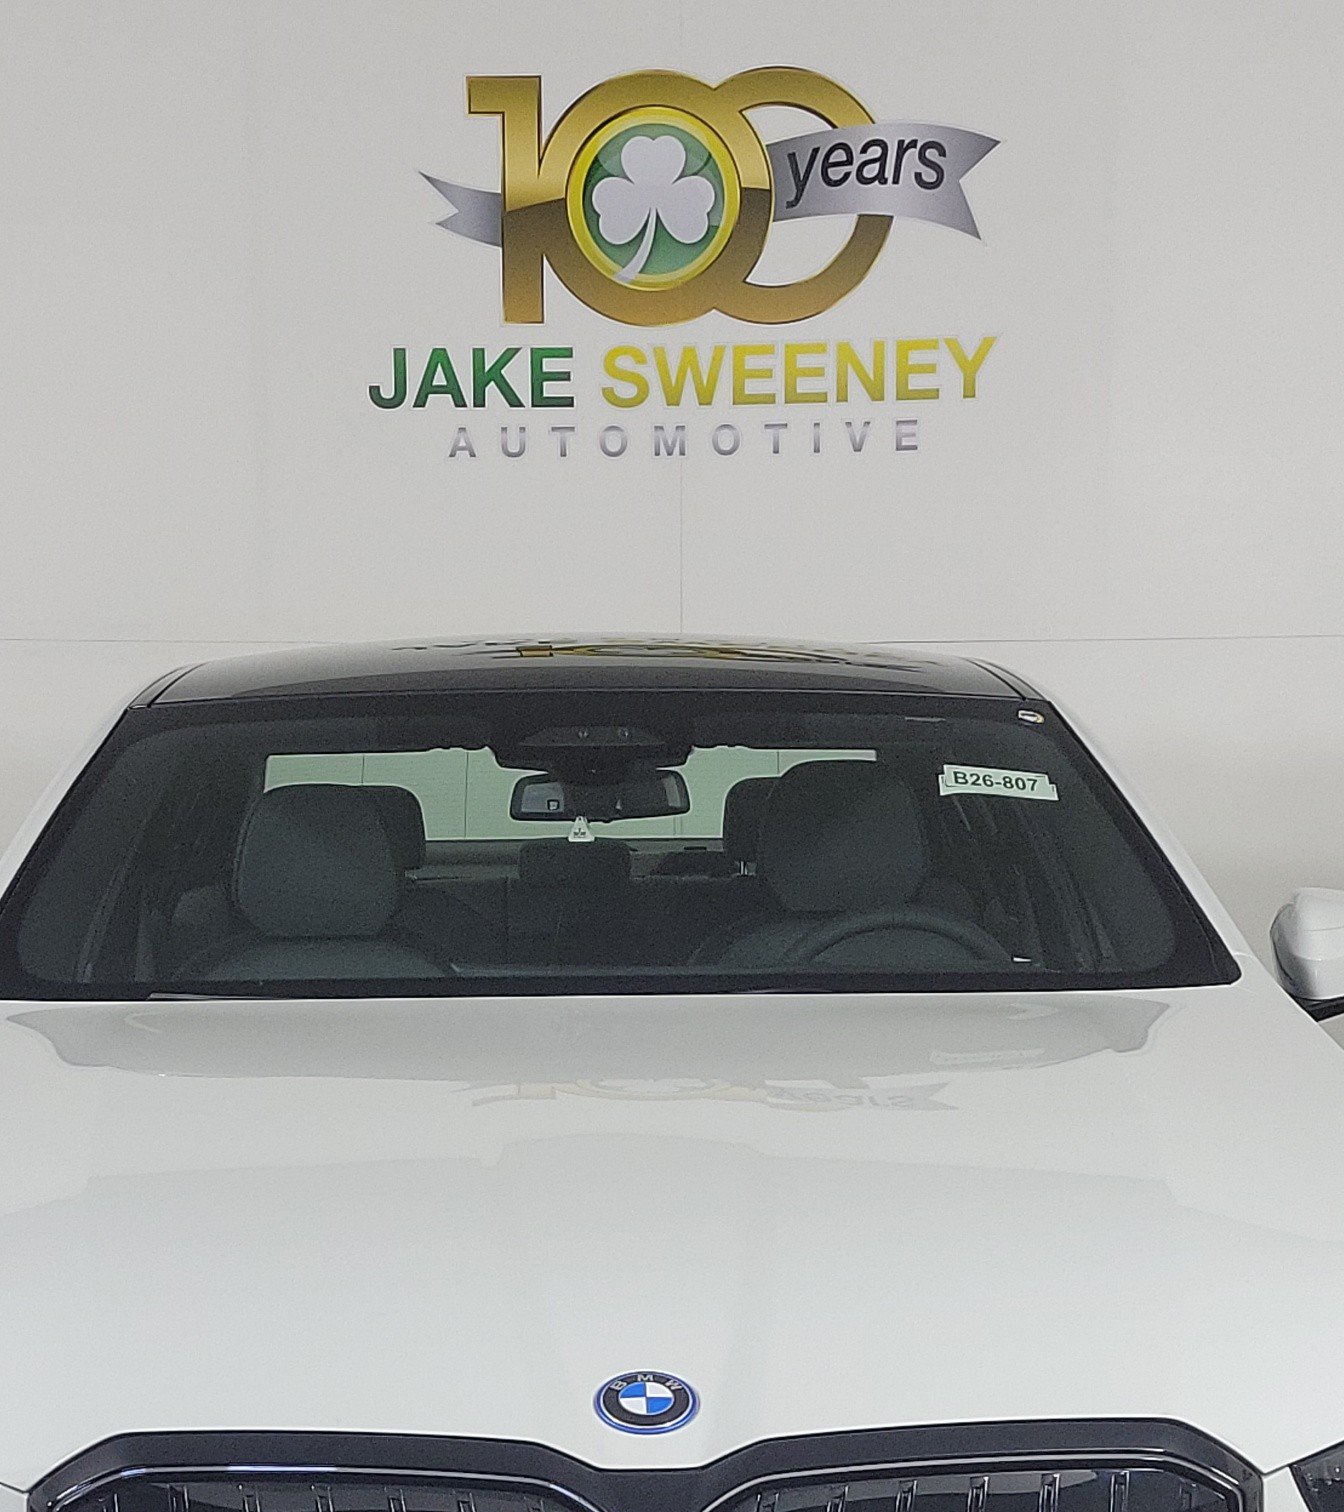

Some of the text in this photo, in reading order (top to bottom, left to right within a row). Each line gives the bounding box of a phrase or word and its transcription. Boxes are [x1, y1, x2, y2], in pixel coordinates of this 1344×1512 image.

[465, 66, 947, 327] 100 years
[368, 336, 997, 409] JAKE SWEENEY
[448, 418, 919, 458] AUTOMOTIVE
[952, 771, 1038, 792] B26-807
[610, 1374, 683, 1390] BMW
